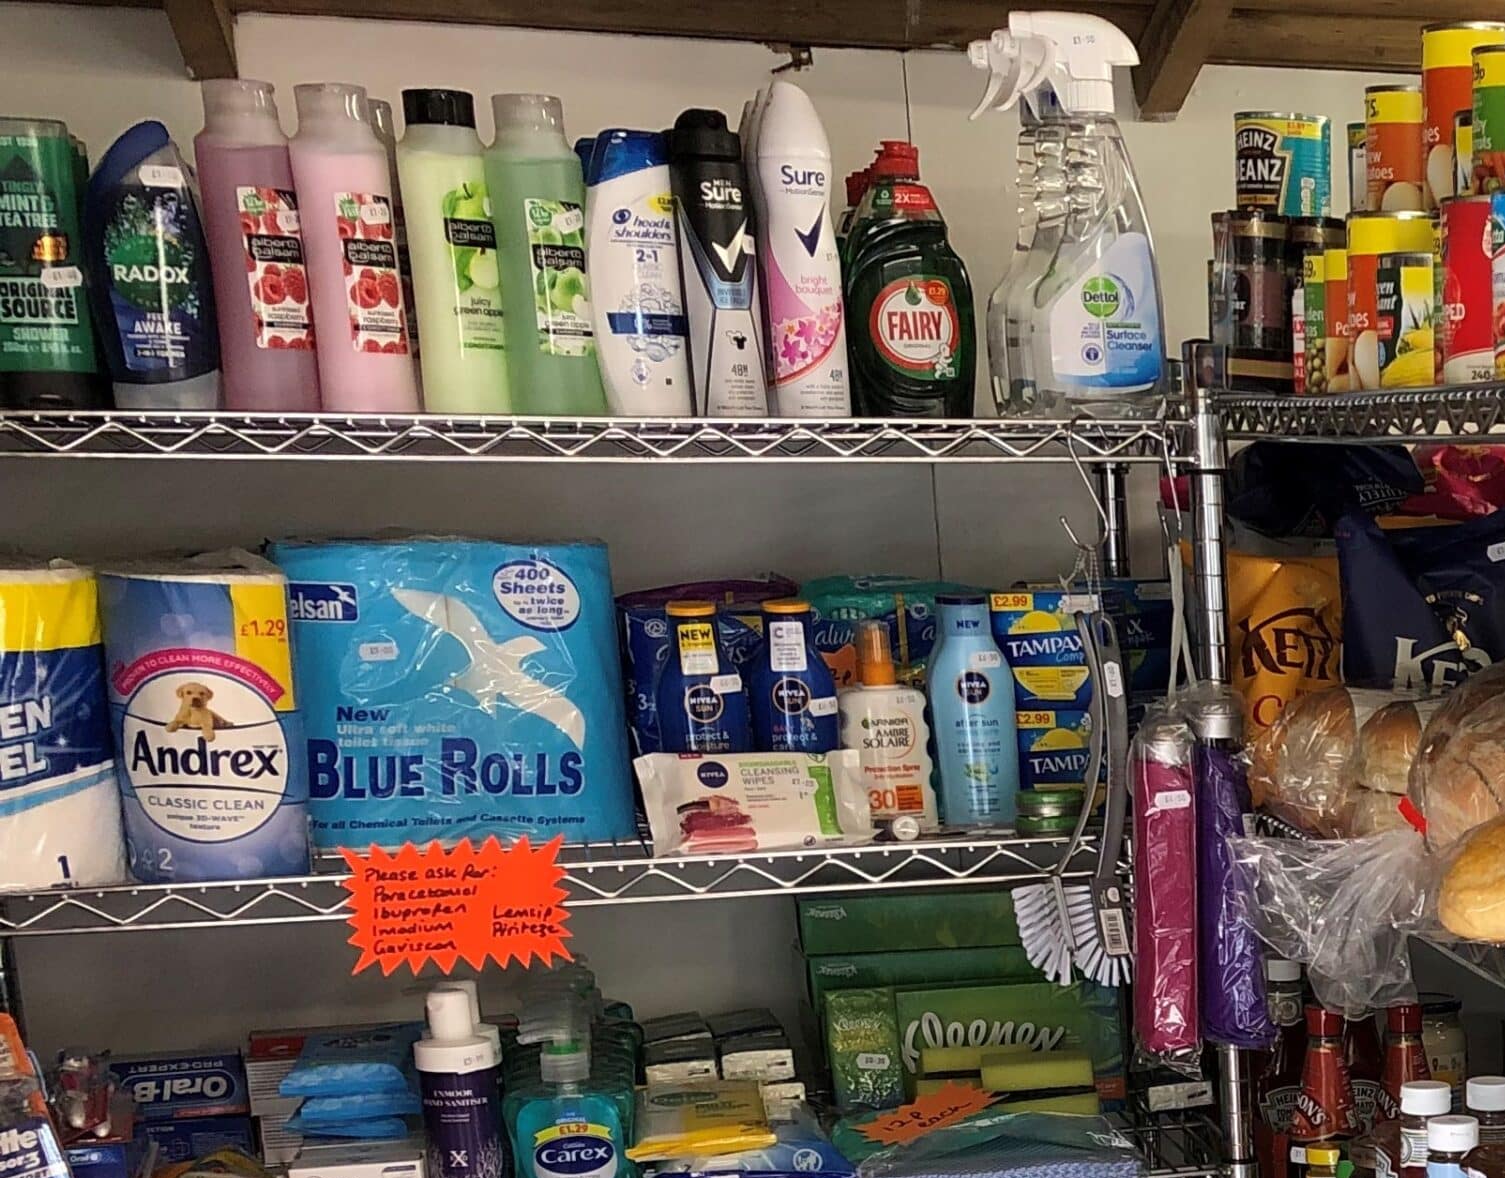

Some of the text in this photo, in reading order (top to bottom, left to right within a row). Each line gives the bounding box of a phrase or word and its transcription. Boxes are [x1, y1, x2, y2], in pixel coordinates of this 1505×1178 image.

[1238, 129, 1275, 151] HEINZ
[781, 165, 825, 187] Sure
[701, 182, 742, 203] Sure
[113, 265, 189, 285] RADOX
[1083, 290, 1120, 304] Dettol
[2, 300, 75, 320] SOURCE
[887, 311, 942, 341] FAIRY
[1106, 329, 1147, 341] Surface
[1106, 340, 1152, 351] Cleanser
[514, 567, 550, 582] 400
[500, 581, 566, 595] Sheets
[530, 596, 565, 606] twice
[993, 596, 1028, 608] £2.99
[241, 619, 285, 638] £1.29
[956, 619, 980, 629] NEW
[680, 627, 711, 641] NEW
[336, 706, 391, 722] New
[1015, 713, 1050, 725] £2.99
[862, 737, 911, 749] SOLAIRE
[132, 730, 279, 779] Andrex
[307, 737, 584, 799] BLUE ROLLS
[740, 767, 800, 777] CLEANSING
[743, 777, 775, 785] WIPES
[147, 795, 264, 811] CLASSIC CLEAN
[349, 815, 585, 829] Chemical Toilets Systems
[364, 866, 457, 882] Please ask
[373, 904, 553, 921] Ibuprofen Lemsip
[372, 919, 454, 937] Imodium
[373, 938, 457, 955] Gaviscon
[133, 1076, 228, 1103] Oral-B
[540, 1144, 609, 1165] Carex
